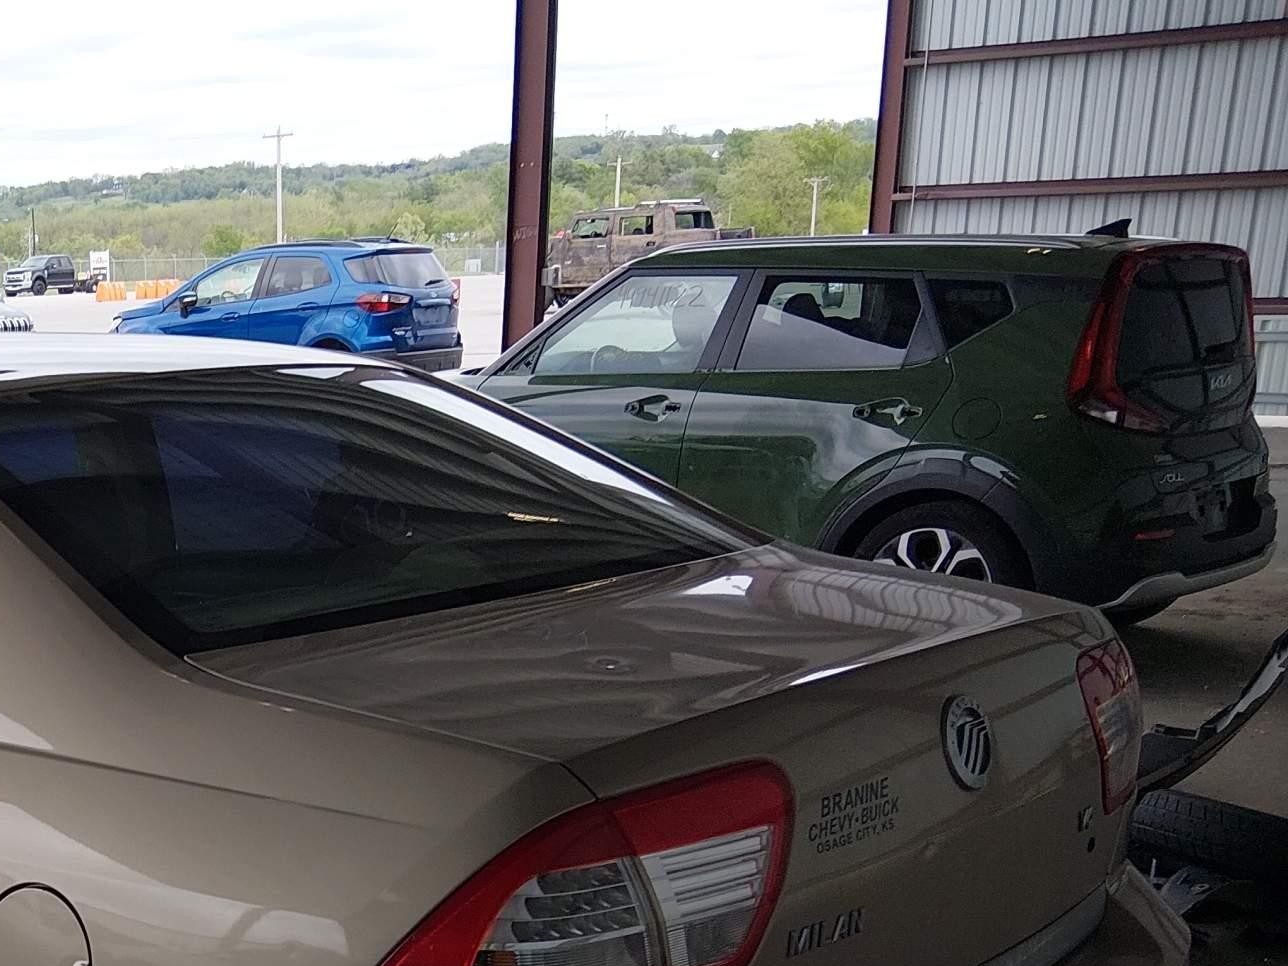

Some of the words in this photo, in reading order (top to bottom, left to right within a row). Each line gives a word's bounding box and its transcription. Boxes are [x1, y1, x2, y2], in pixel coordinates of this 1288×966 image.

[820, 776, 889, 818] BRANINE
[816, 831, 854, 854] OSAGE
[881, 817, 895, 833] KS
[785, 905, 865, 958] MILAN
